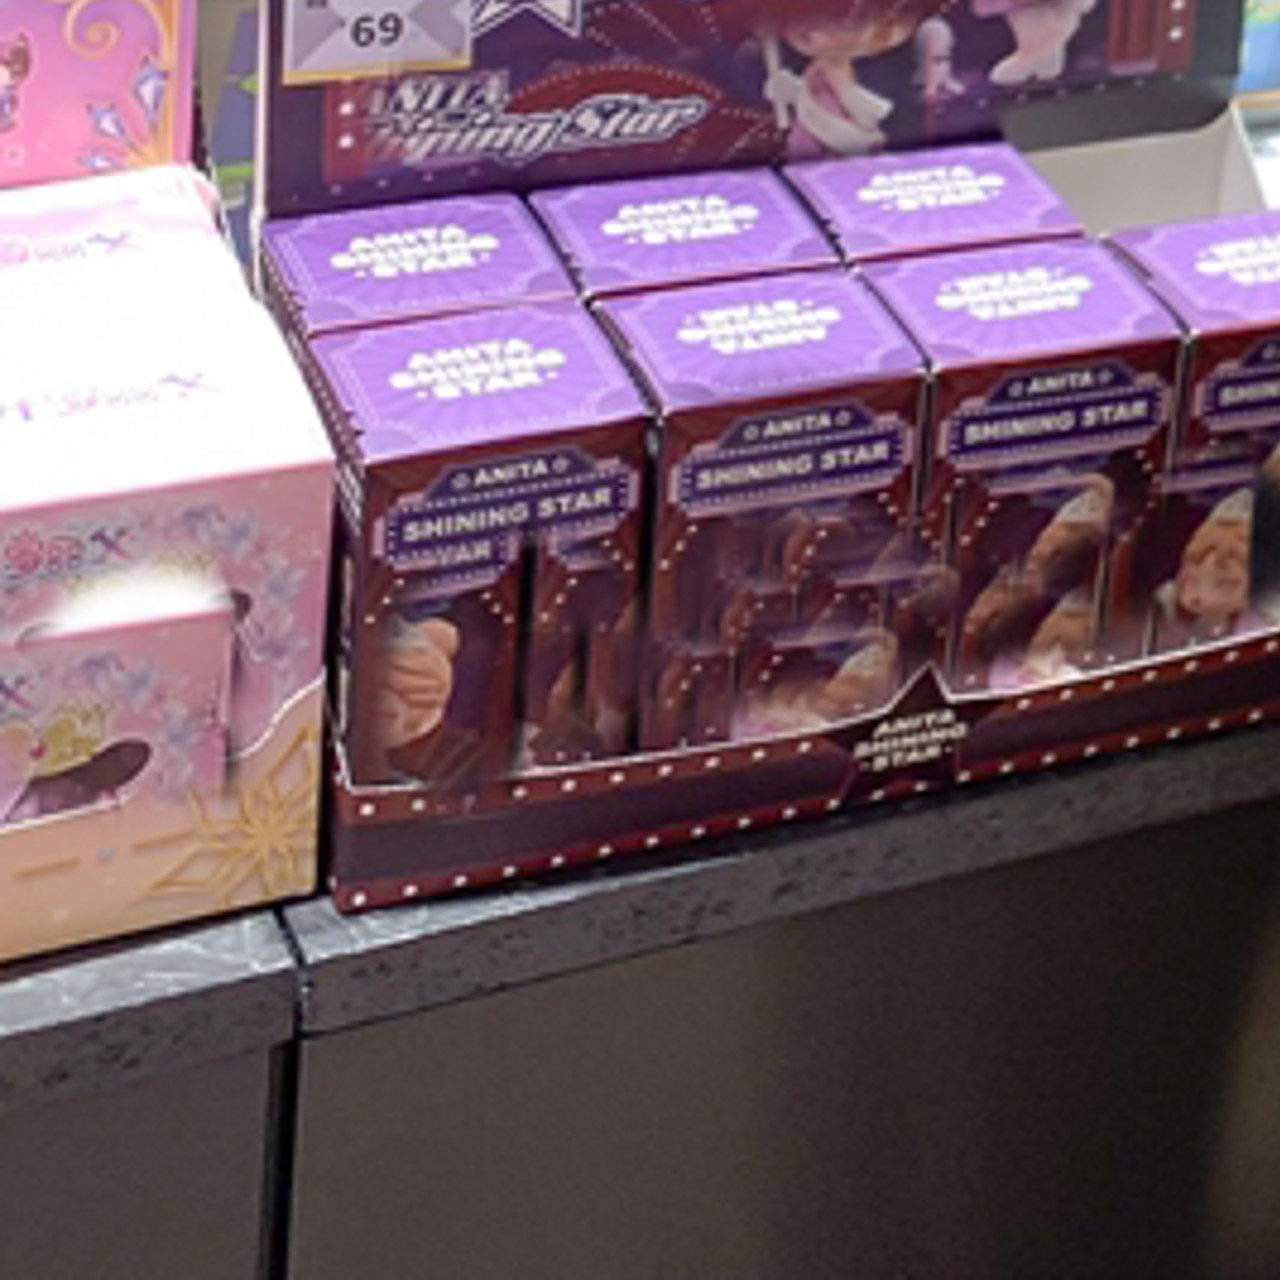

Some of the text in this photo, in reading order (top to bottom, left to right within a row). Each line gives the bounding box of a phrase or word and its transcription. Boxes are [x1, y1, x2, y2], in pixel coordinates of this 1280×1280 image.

[351, 11, 404, 48] 69
[1027, 371, 1095, 396] ANITA
[763, 411, 832, 438] ANITA
[964, 399, 1149, 447] SHINING STAR
[474, 457, 549, 486] ANITA
[695, 442, 890, 490] SHINING STAR
[402, 487, 612, 541] SHINING STAR
